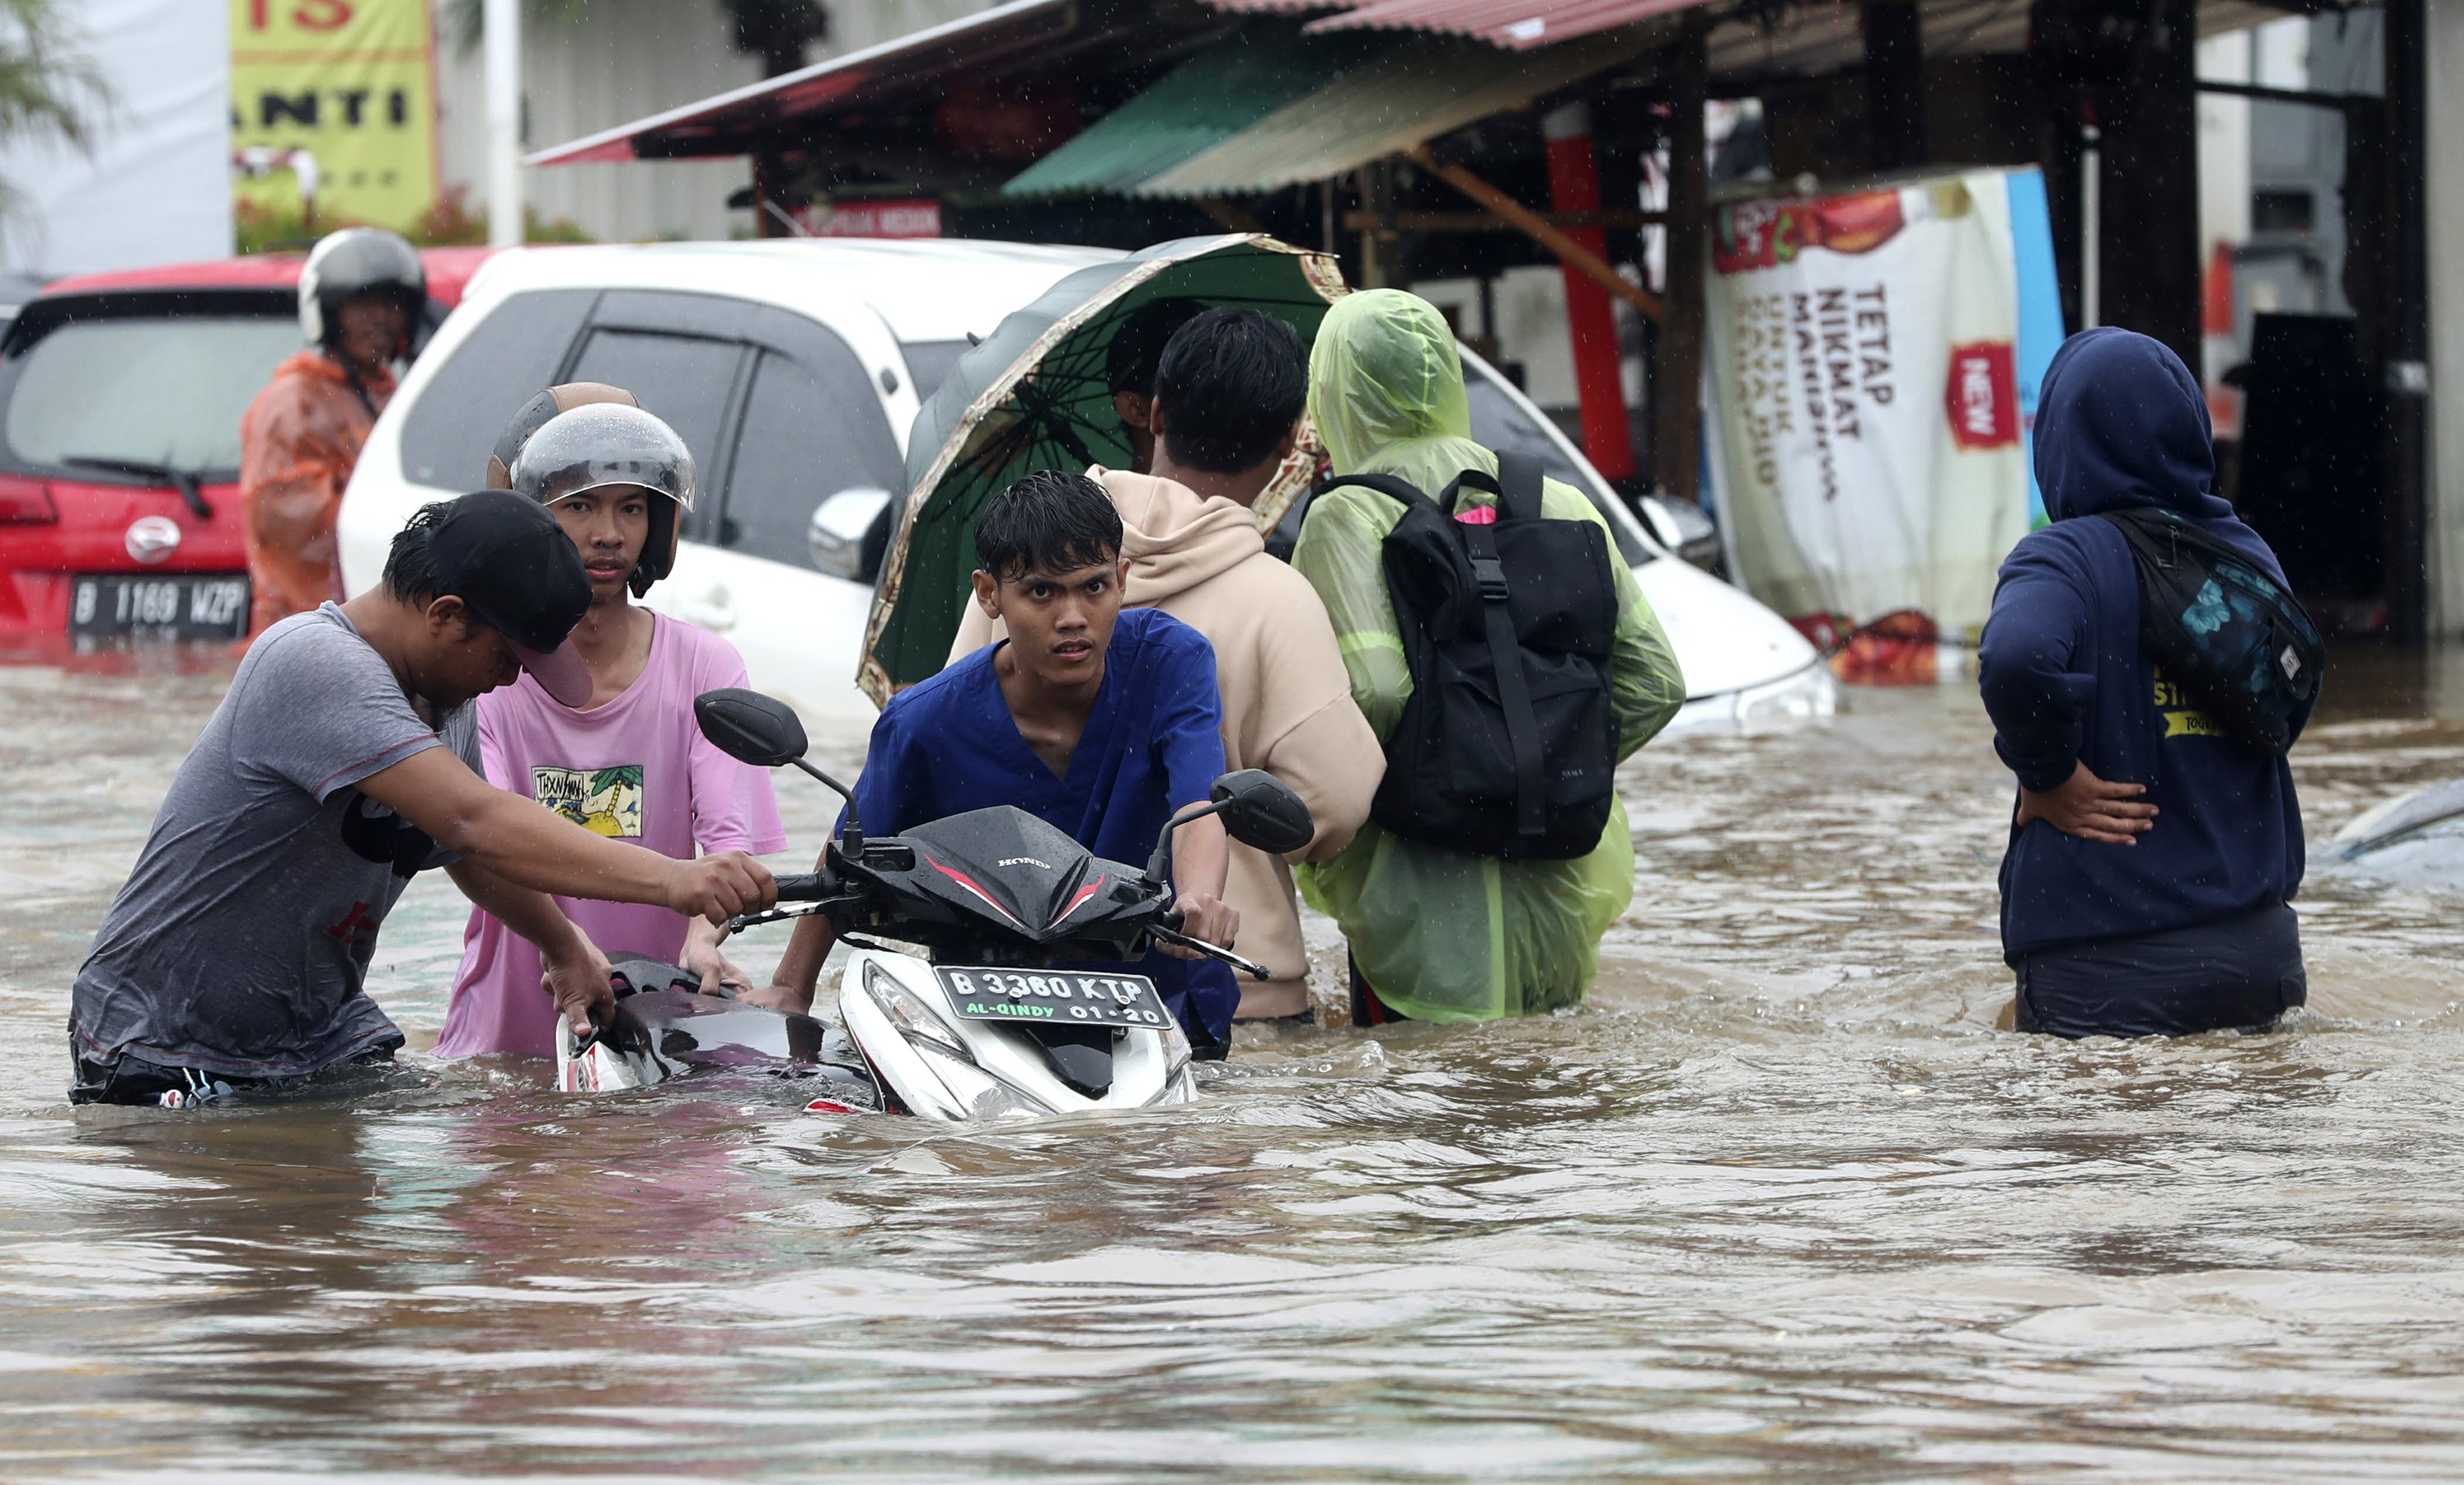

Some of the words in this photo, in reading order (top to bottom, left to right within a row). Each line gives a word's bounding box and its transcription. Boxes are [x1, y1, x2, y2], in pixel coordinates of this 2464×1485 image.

[1768, 293, 1796, 434] UNTUK
[1817, 287, 1863, 440] NIKMAT
[1855, 283, 1894, 406] TETAP
[1961, 356, 1996, 436] NEW
[75, 581, 98, 624] B
[116, 581, 180, 624] 1169
[997, 857, 1051, 870] HONDA
[949, 972, 977, 995] B
[1076, 977, 1142, 1002] KTP
[966, 1002, 1055, 1018] AL-QINDY
